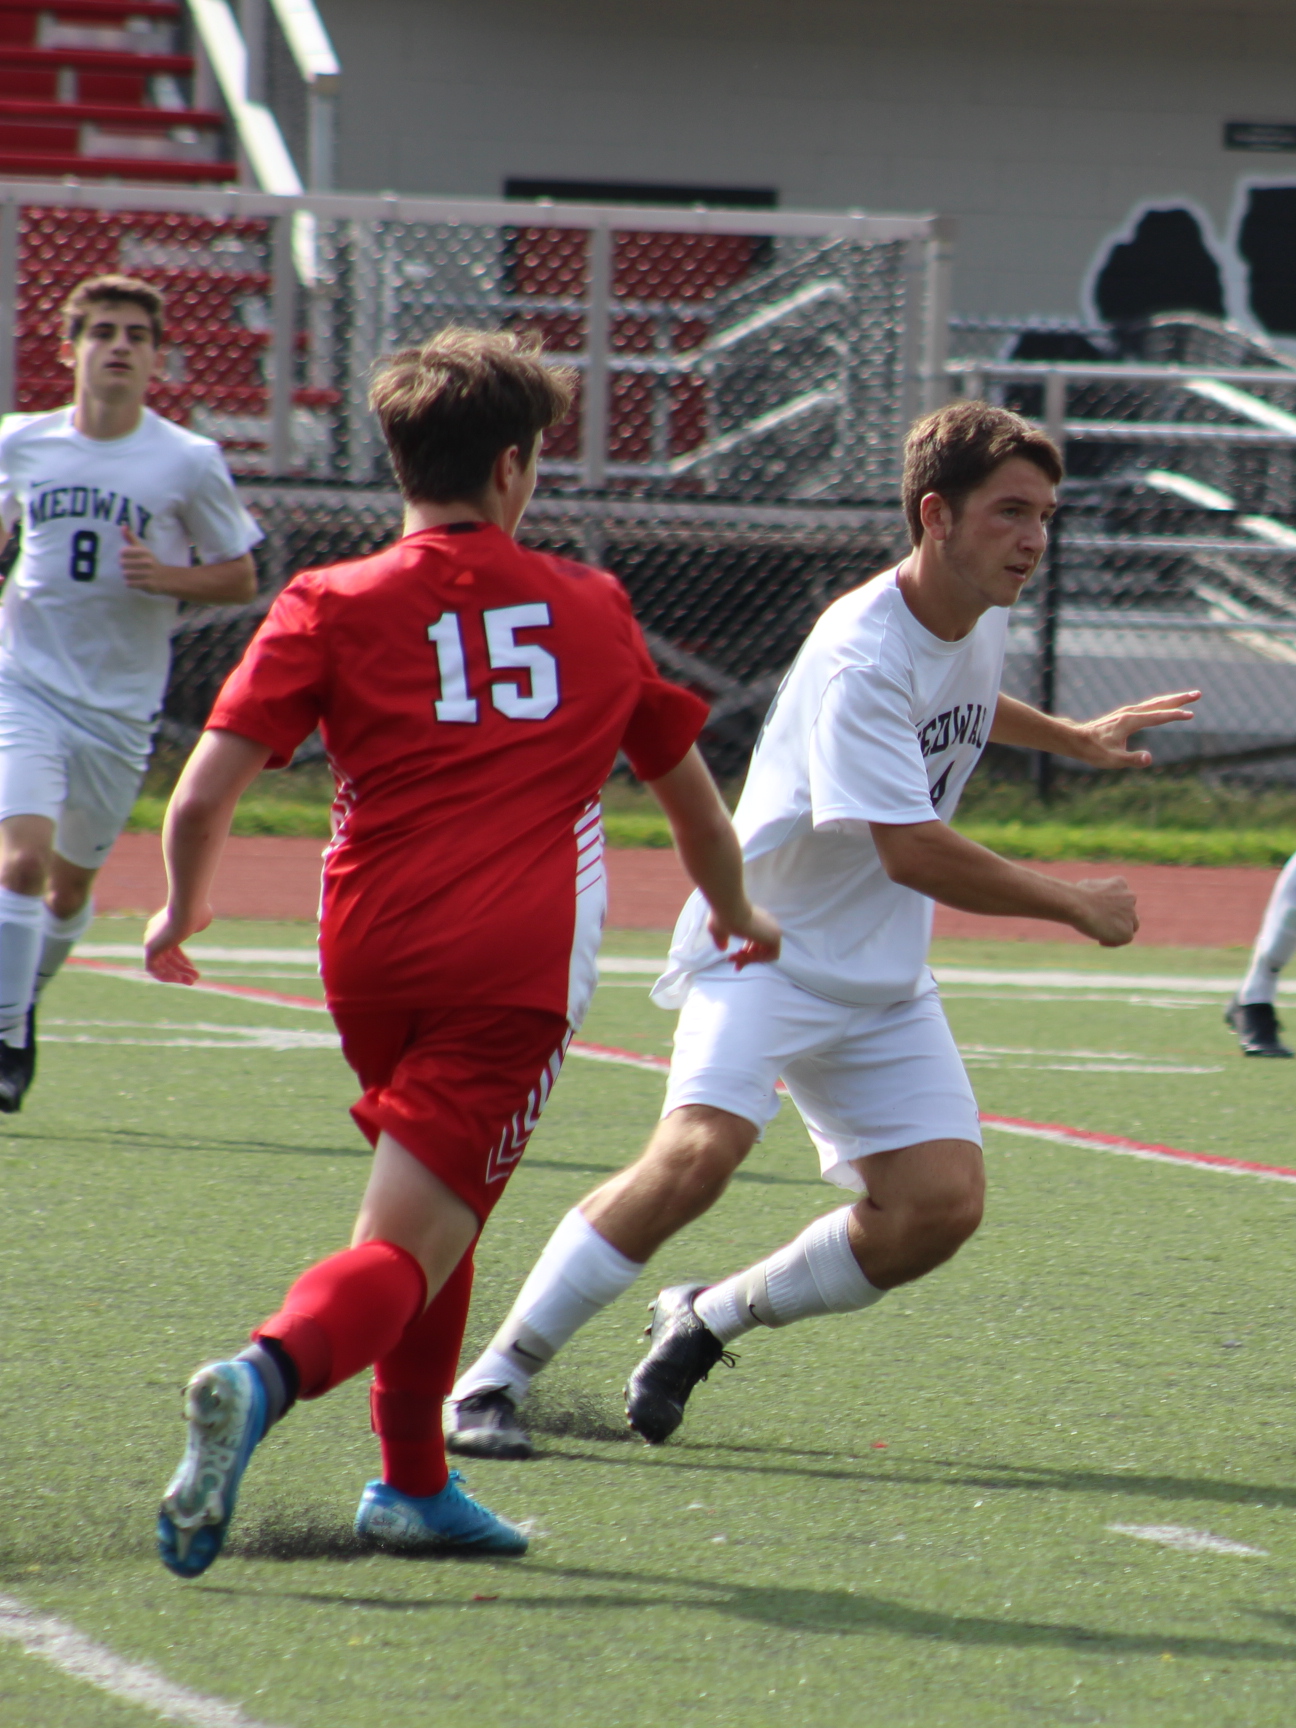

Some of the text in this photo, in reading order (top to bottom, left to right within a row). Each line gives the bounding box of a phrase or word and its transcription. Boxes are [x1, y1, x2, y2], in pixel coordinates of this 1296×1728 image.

[30, 486, 152, 539] MEDWAY
[71, 530, 98, 582] 8
[427, 602, 560, 724] 15
[918, 703, 987, 758] EDWA
